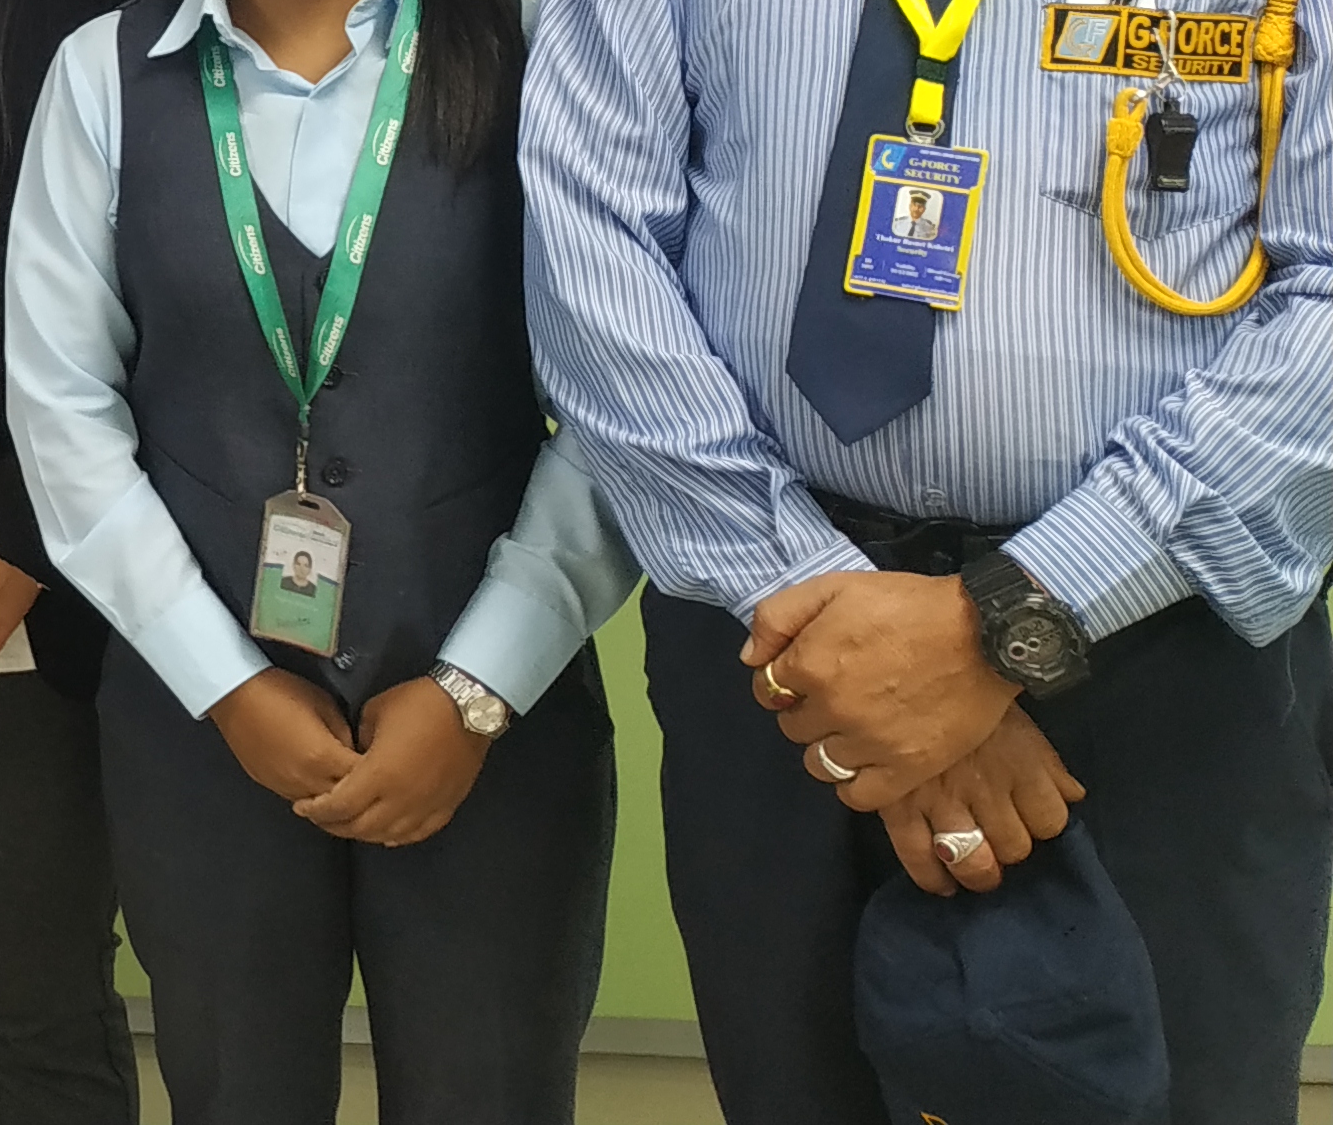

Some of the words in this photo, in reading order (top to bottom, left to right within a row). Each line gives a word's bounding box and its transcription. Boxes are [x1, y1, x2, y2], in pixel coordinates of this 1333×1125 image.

[1132, 55, 1233, 75] SEURITY
[226, 131, 242, 177] Citizens
[376, 117, 400, 166] Citizens
[903, 168, 963, 185] SECURITY
[908, 158, 961, 173] G-FORCE
[244, 224, 266, 276] Citizens
[349, 213, 373, 265] Citizens
[318, 314, 345, 366] Citizens
